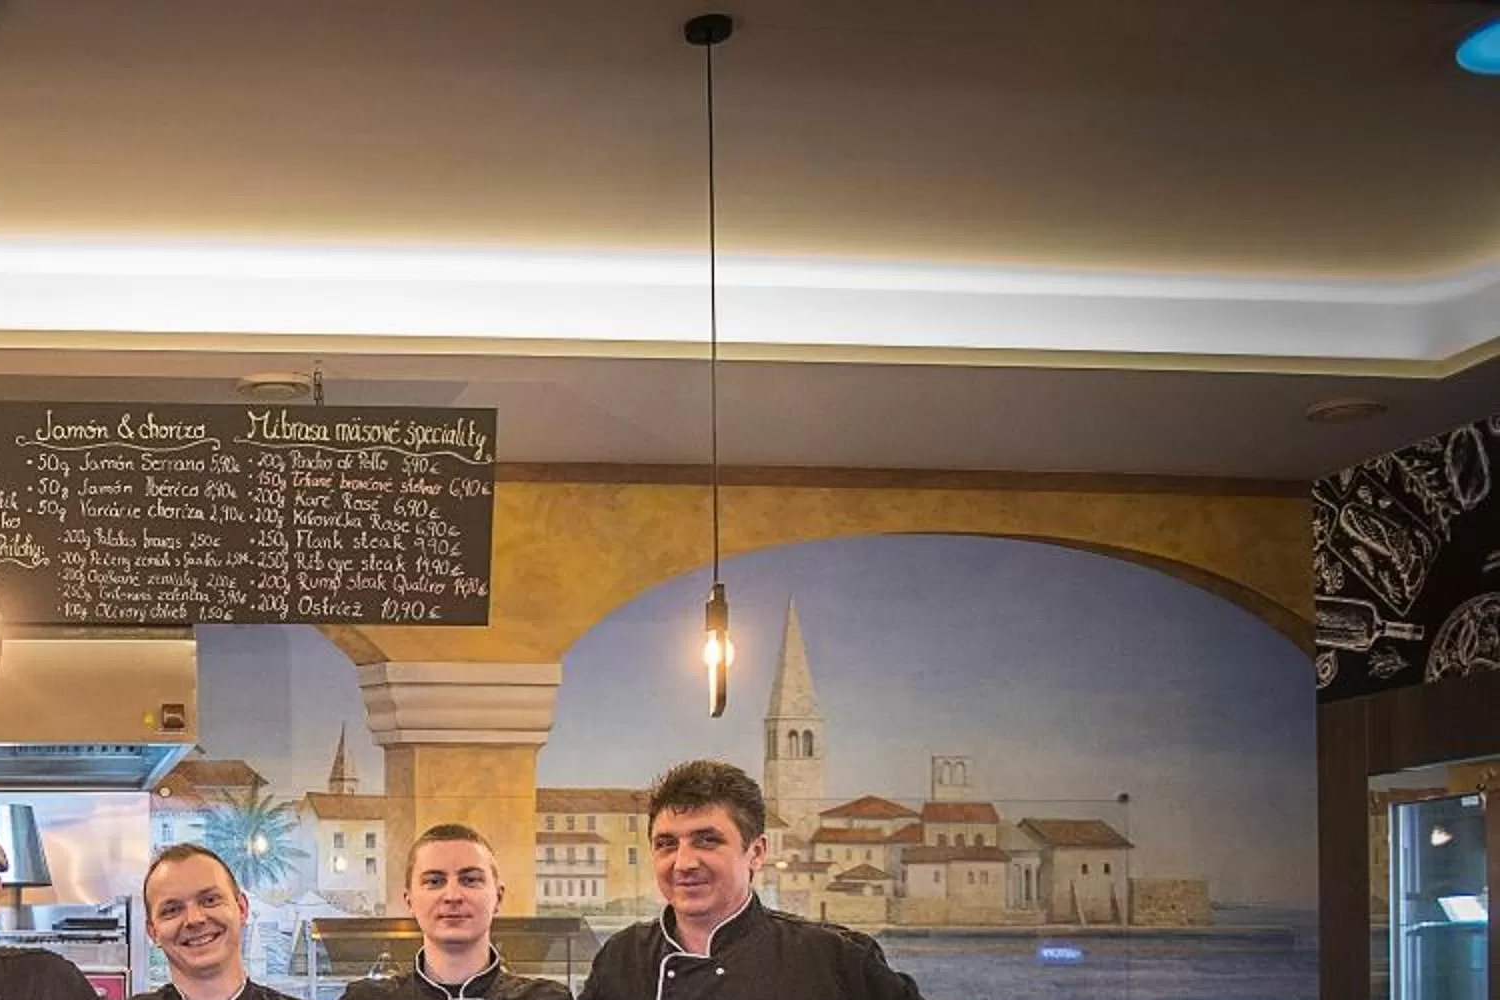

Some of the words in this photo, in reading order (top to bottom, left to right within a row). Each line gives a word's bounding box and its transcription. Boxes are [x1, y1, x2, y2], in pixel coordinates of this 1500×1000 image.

[35, 409, 109, 441] Jamón
[117, 412, 135, 439] &
[138, 411, 205, 440] chorizo
[335, 416, 401, 444] mäsové
[37, 453, 71, 478] 50g
[78, 452, 135, 472] Jamón
[141, 453, 205, 473] Serrano
[37, 477, 69, 500] 50g
[77, 477, 133, 498] Jamón
[37, 499, 67, 523] 50g
[296, 529, 344, 550] Flank
[352, 527, 407, 551] steak
[361, 553, 407, 574] steak
[346, 574, 387, 592] steak
